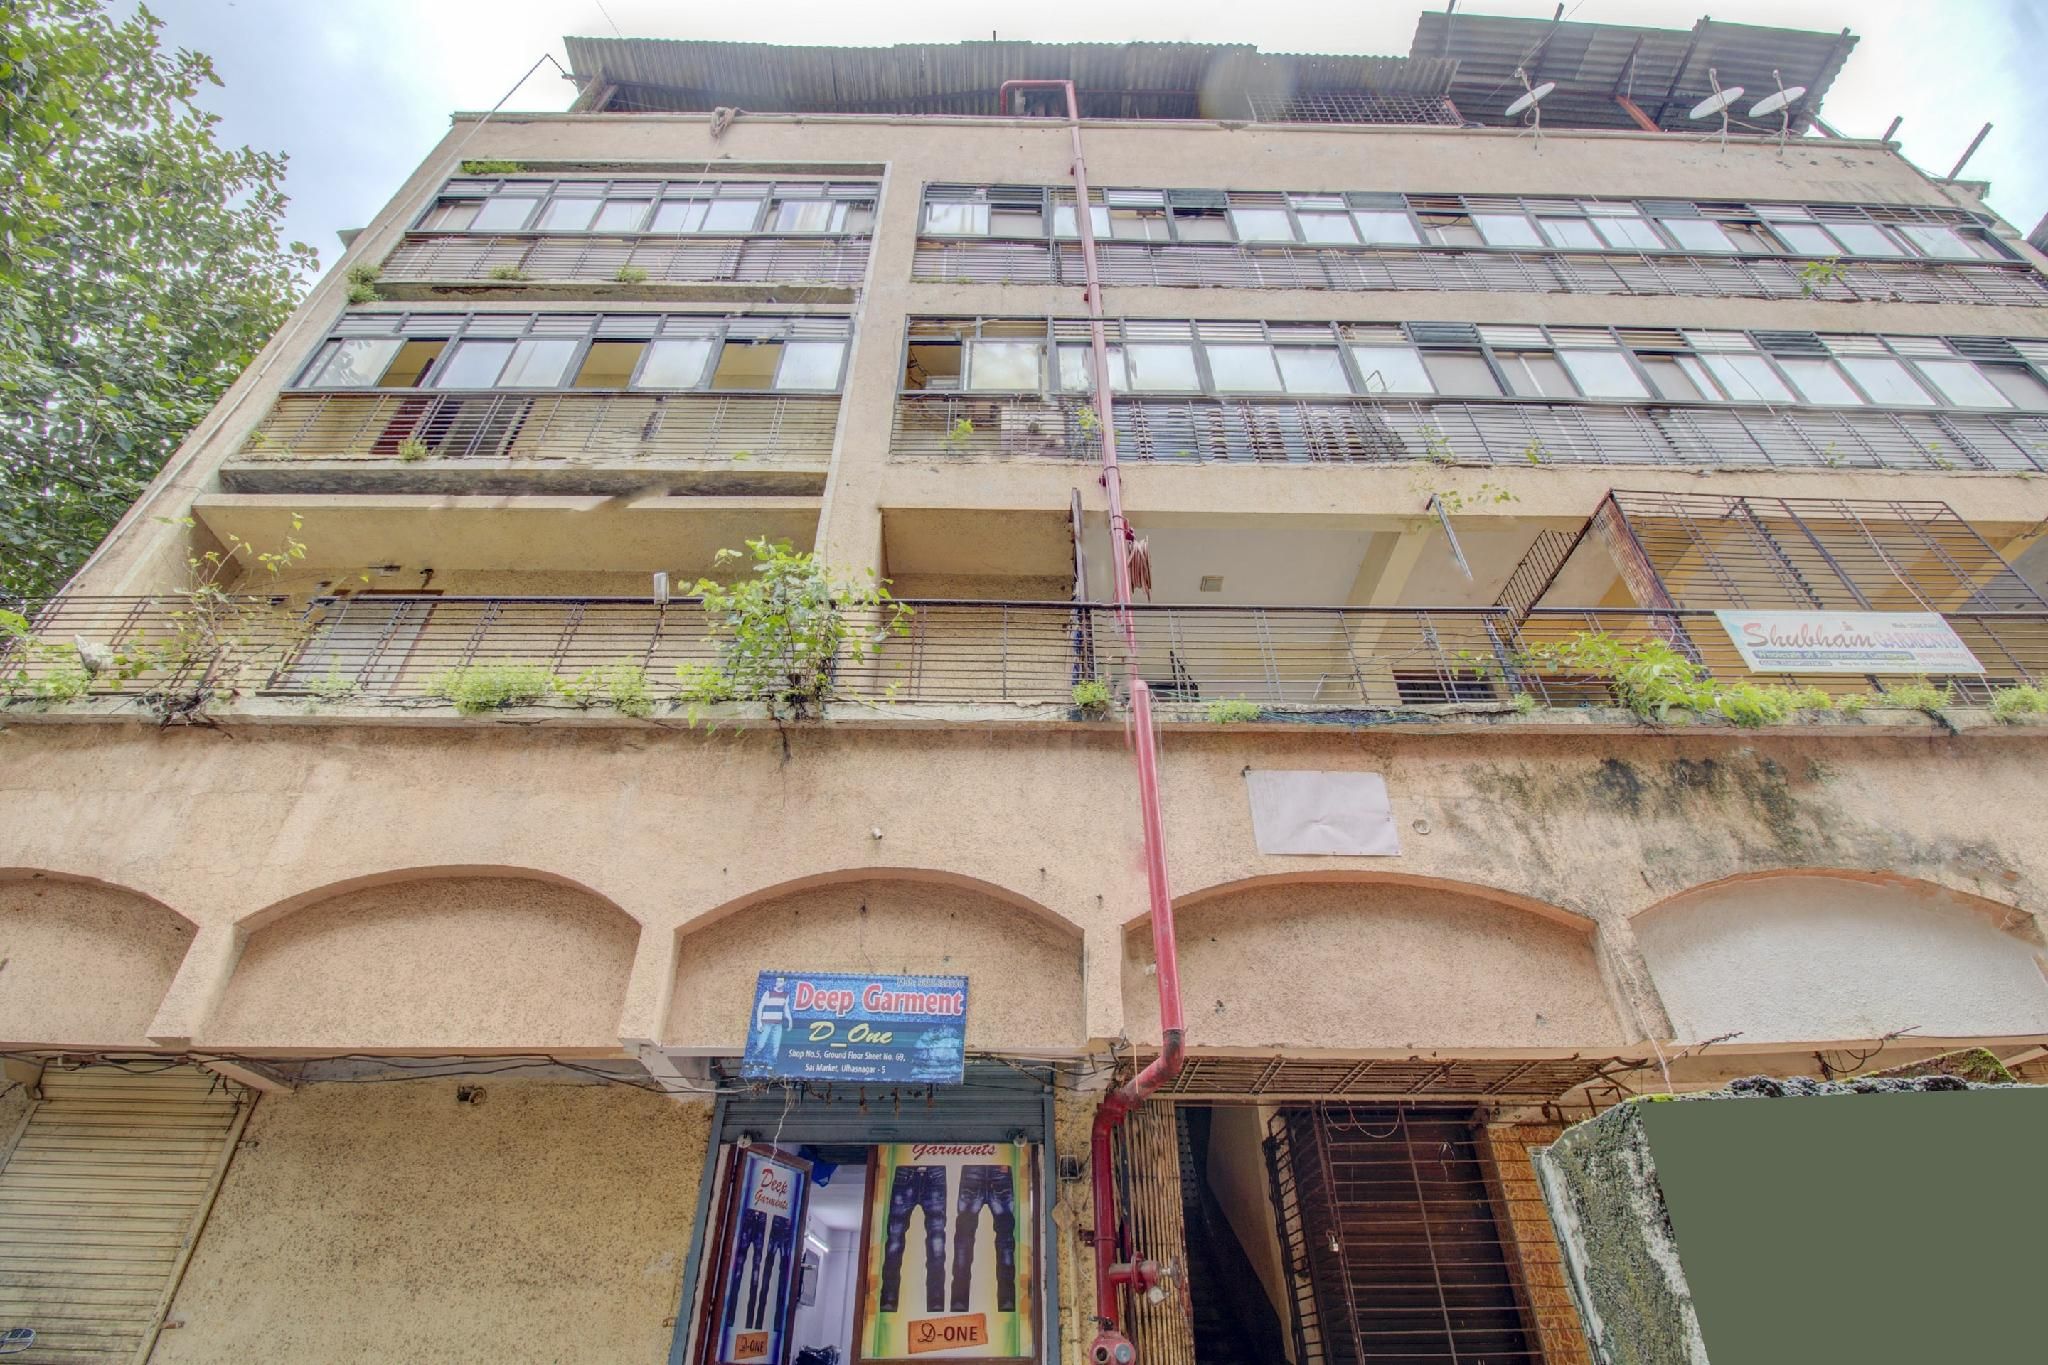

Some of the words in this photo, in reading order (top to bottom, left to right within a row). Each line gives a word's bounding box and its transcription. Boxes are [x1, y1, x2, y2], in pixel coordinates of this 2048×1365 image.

[1743, 622, 1876, 647] Shubham
[794, 981, 854, 1017] Deep
[863, 984, 963, 1016] Garment
[788, 1049, 804, 1060] Shop
[823, 1050, 846, 1060] Ground
[841, 1064, 876, 1076] Ulhasnagar
[881, 1065, 886, 1074] 5
[912, 1143, 996, 1161] Garments
[761, 1168, 788, 1197] Deep
[917, 1321, 979, 1343] D-ONE
